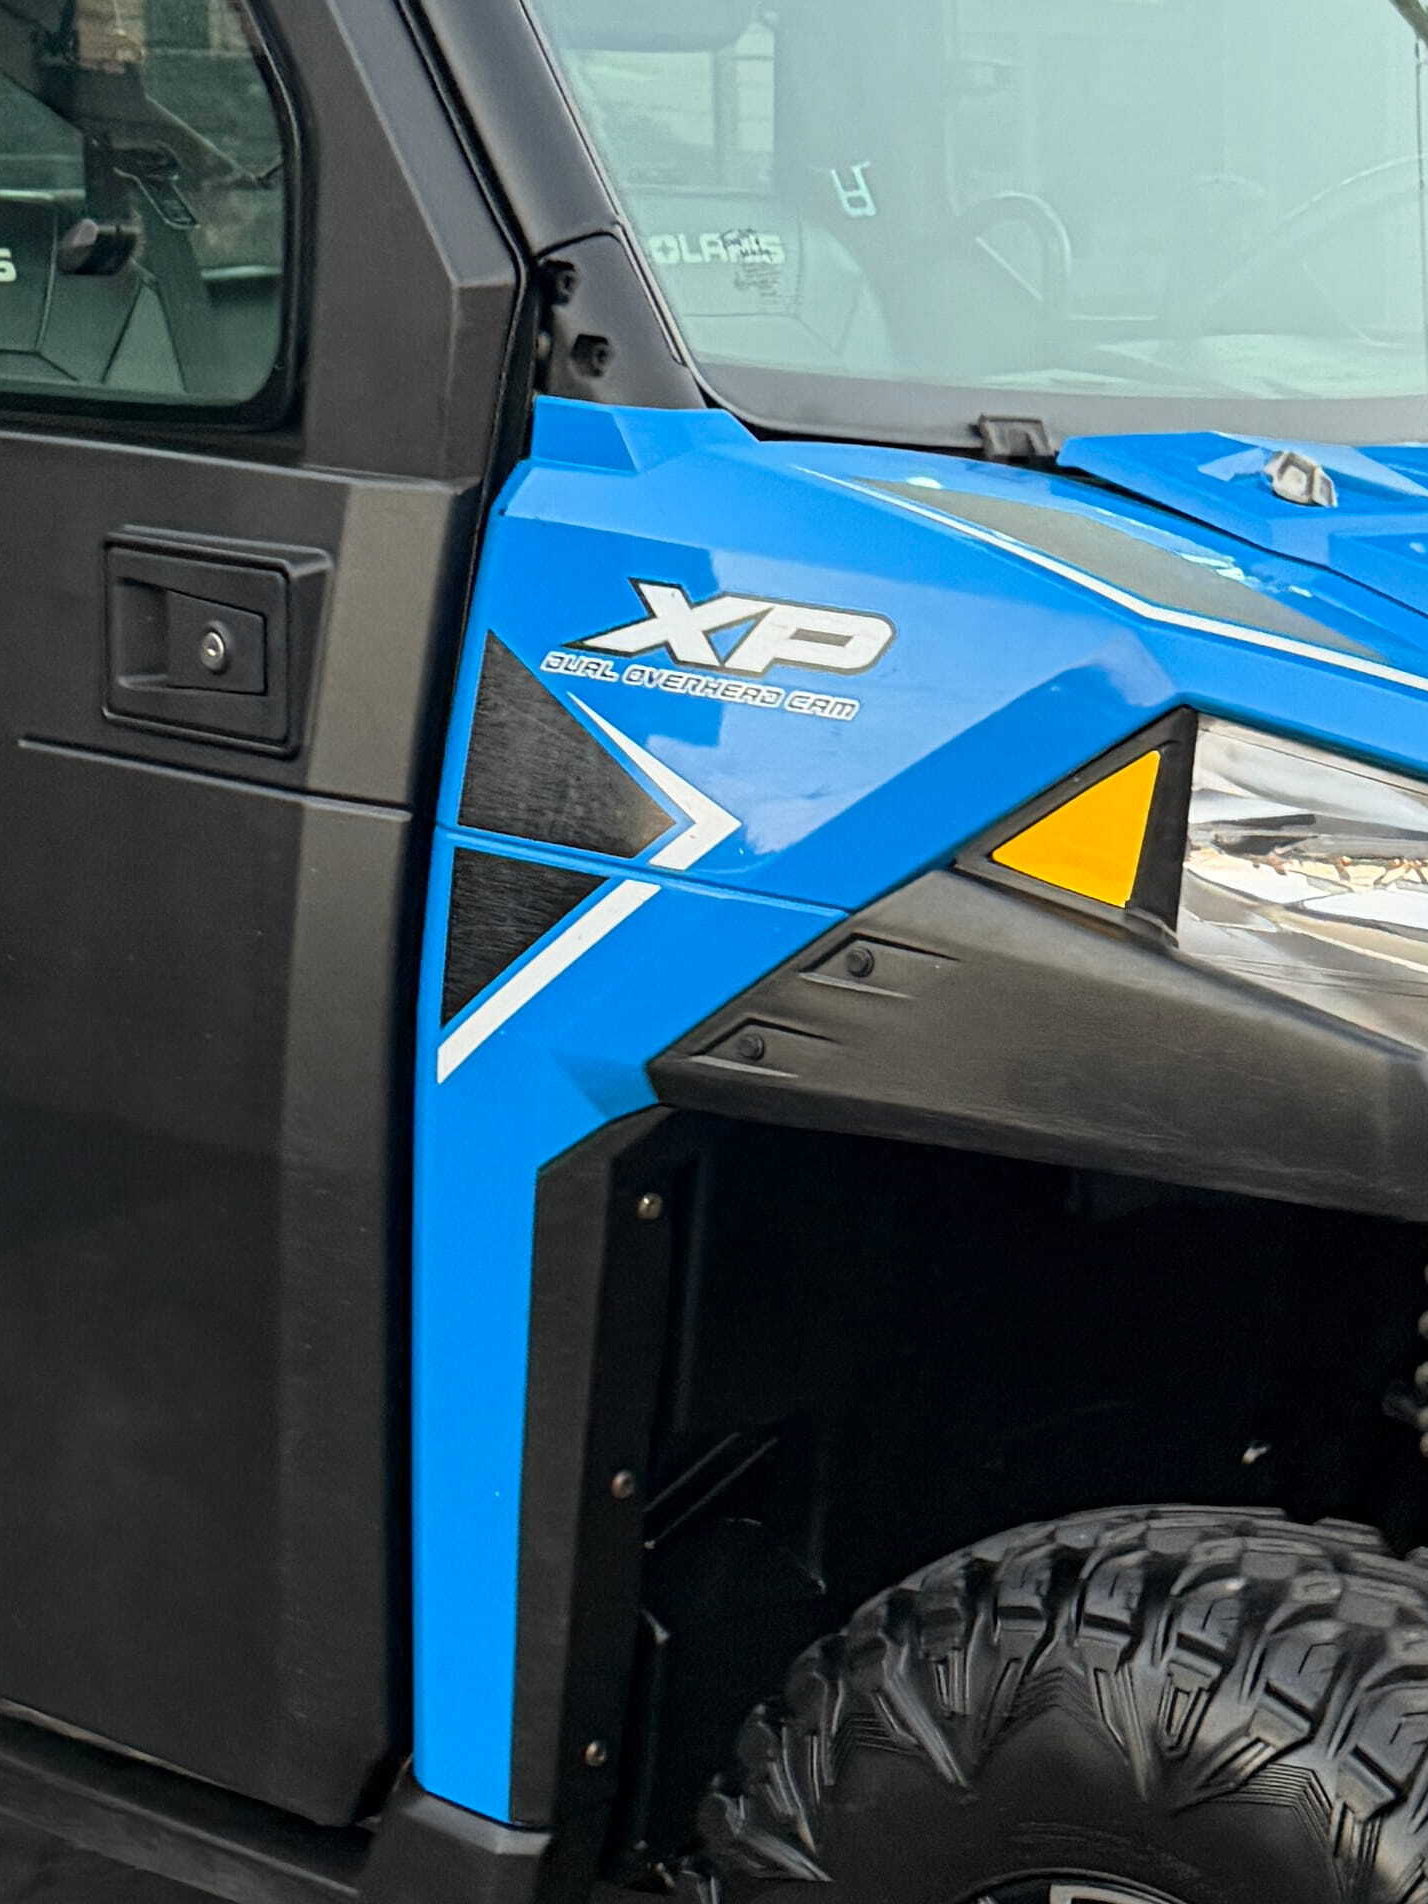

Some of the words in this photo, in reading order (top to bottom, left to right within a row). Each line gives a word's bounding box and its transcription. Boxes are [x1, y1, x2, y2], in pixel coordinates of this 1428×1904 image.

[562, 577, 898, 676] XP
[541, 651, 618, 682] DUAL
[622, 664, 786, 707] OVERHEAD
[785, 691, 859, 720] CAM
